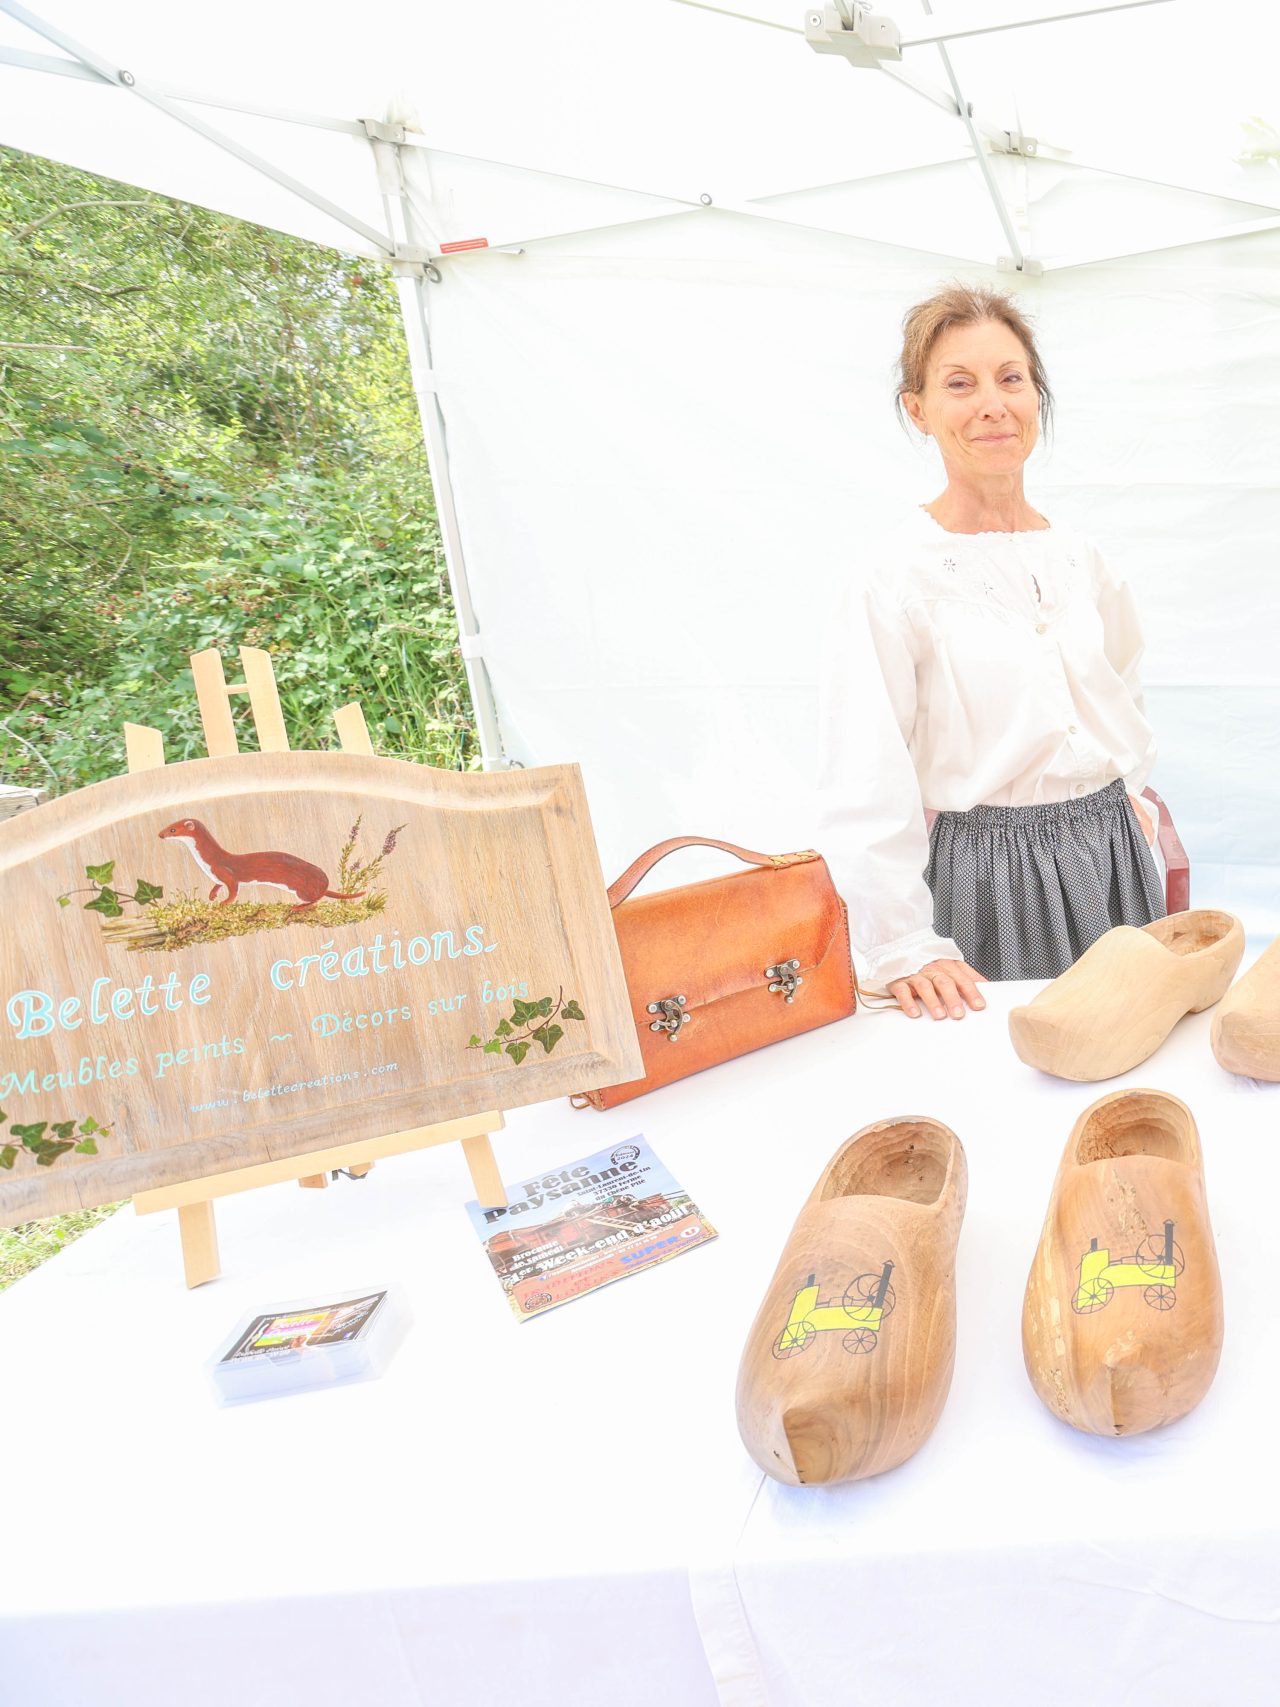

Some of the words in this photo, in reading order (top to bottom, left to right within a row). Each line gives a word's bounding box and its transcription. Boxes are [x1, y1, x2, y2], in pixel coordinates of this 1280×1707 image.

[6, 972, 211, 1040] Belette
[0, 1056, 138, 1100] Meubles
[155, 1034, 245, 1079] peints
[311, 1005, 412, 1038] Décors
[427, 993, 467, 1016] sur
[481, 979, 529, 1004] bois
[482, 1161, 638, 1224] Paysanne
[522, 1166, 590, 1197] Fête
[512, 1241, 559, 1262] Brocante
[527, 1245, 563, 1264] samedi
[535, 1230, 629, 1271] Week-end
[620, 1236, 678, 1264] SUPER
